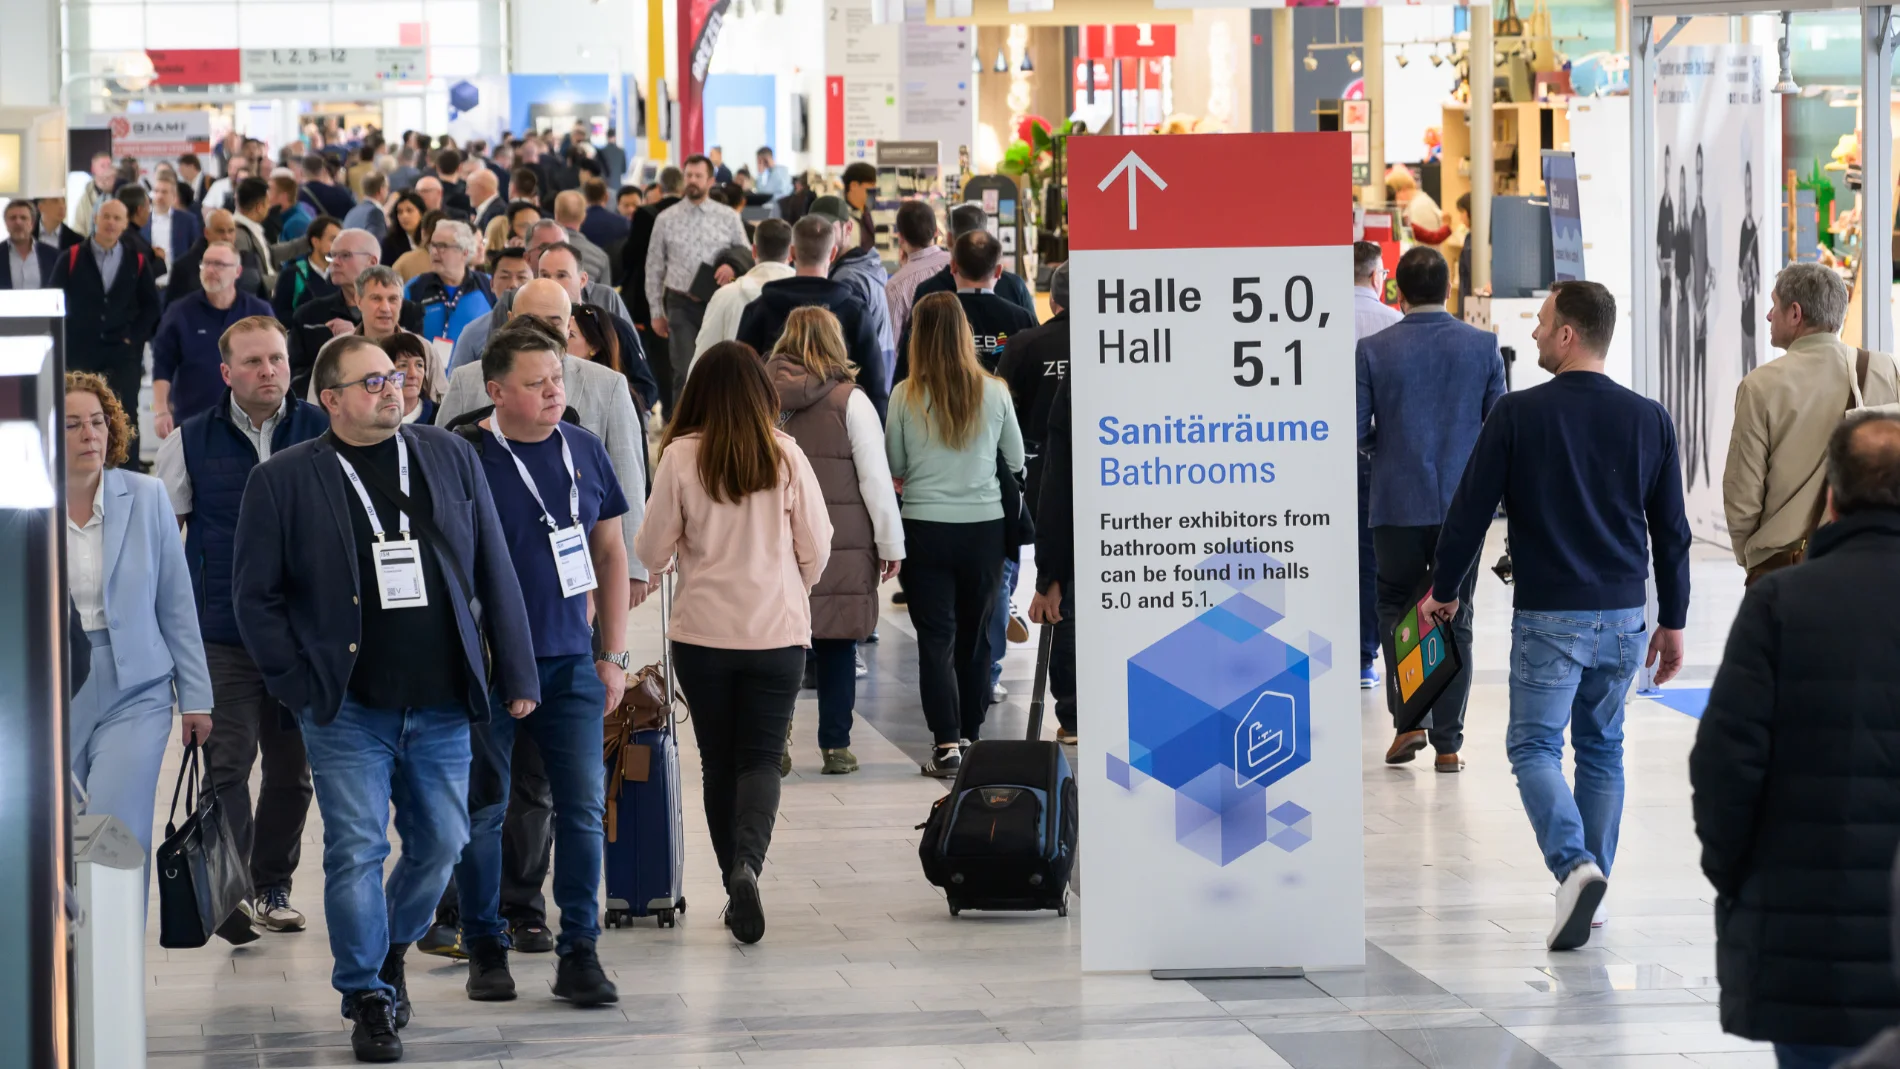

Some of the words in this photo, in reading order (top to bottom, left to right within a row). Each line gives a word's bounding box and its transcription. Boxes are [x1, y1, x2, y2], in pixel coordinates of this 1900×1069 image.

[830, 8, 838, 21] 2
[831, 82, 838, 97] 1
[1098, 278, 1201, 314] Halle
[1233, 275, 1330, 328] 5.0,
[973, 335, 998, 348] EB
[1099, 328, 1171, 364] Hall
[1234, 340, 1302, 387] 5.1
[1043, 361, 1069, 376] ZE
[1099, 414, 1329, 446] Sanitärräume
[1101, 456, 1276, 486] Bathrooms
[1100, 513, 1172, 530] Further
[1178, 511, 1278, 529] exhibitors
[1284, 510, 1330, 527] from
[1100, 539, 1196, 557] bathroom
[1203, 537, 1294, 554] solutions
[1100, 569, 1136, 583] can
[1143, 566, 1167, 582] be
[1174, 564, 1231, 581] found
[1238, 563, 1256, 580] in
[1263, 563, 1309, 580] halls
[1101, 592, 1131, 609] 5.0
[1138, 591, 1174, 608] and
[1182, 590, 1214, 608] 5.1.
